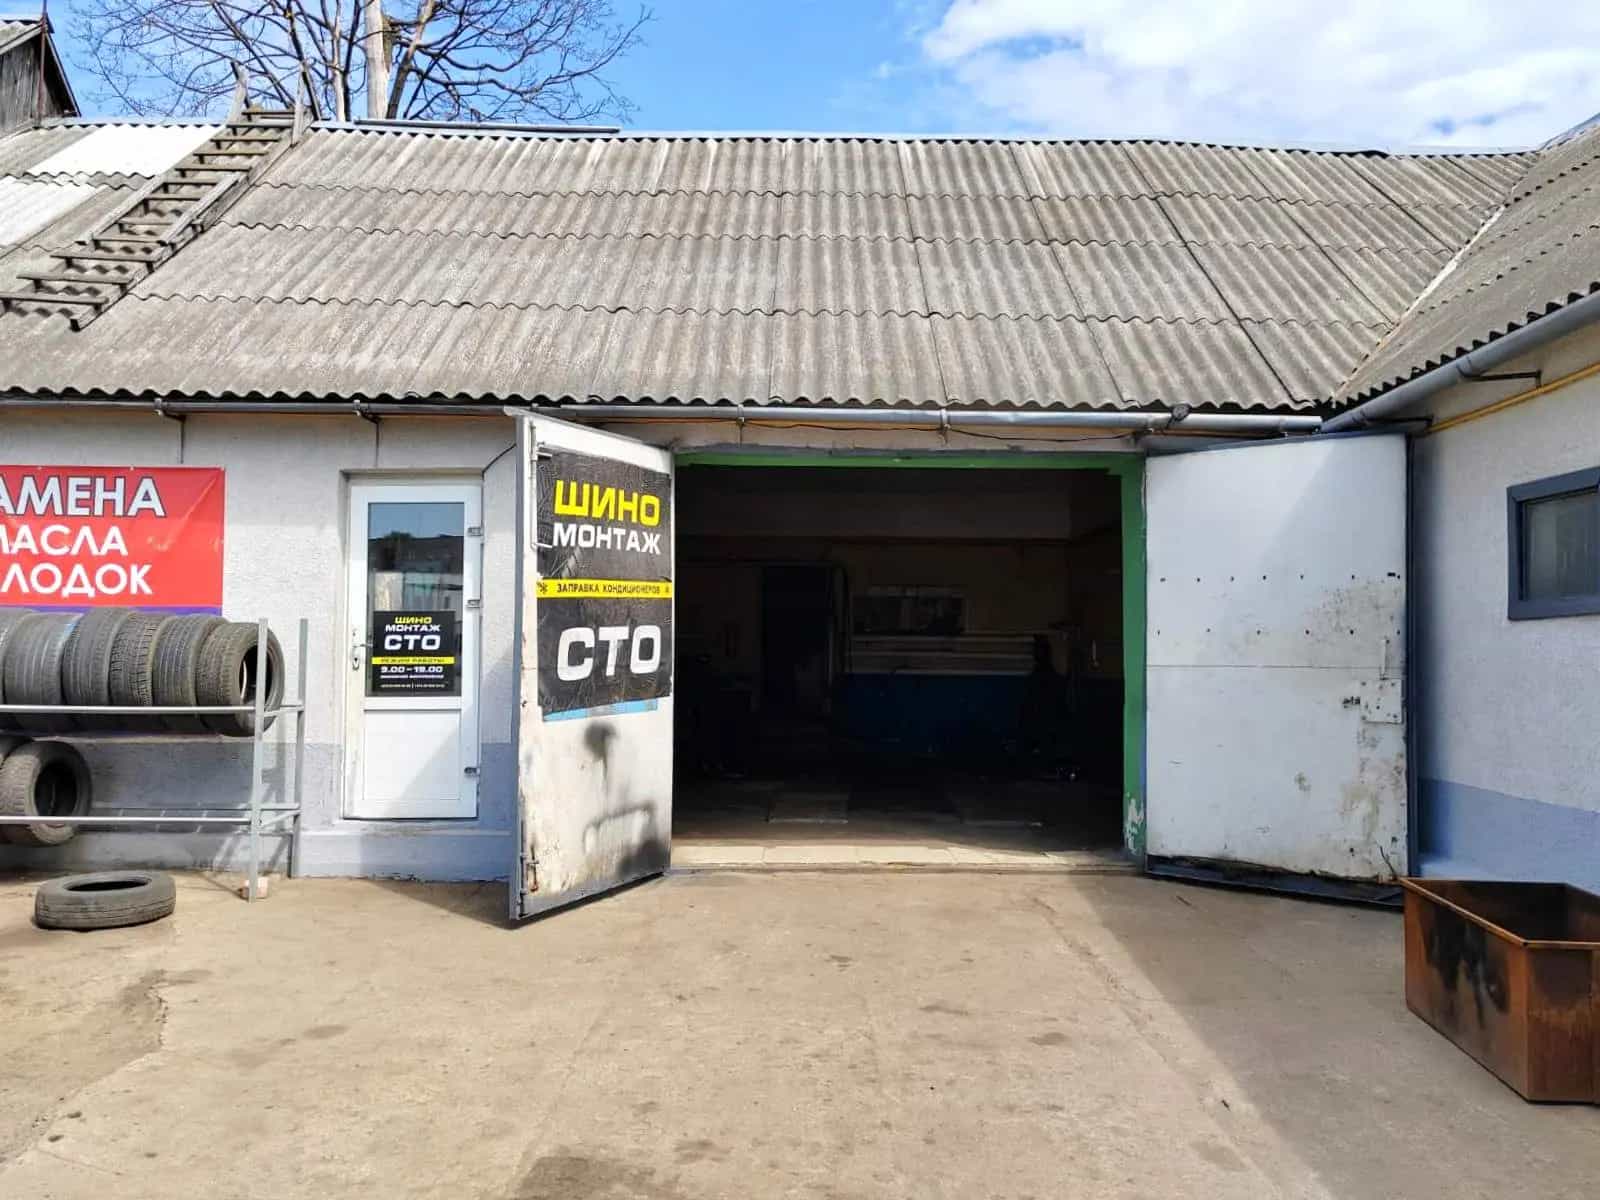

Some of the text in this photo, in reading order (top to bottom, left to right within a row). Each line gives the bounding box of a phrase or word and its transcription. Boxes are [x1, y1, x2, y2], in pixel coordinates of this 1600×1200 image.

[554, 480, 660, 526] ШИНО
[0, 524, 129, 556] АСЛА
[552, 522, 661, 555] МОНТАЖ
[556, 583, 661, 595] ЗАПРАВКА КОНДИЦИОНЕРОВ
[385, 624, 441, 632] МОНТАЖ
[394, 616, 433, 624] ШИНО
[384, 634, 441, 650] СТО
[557, 625, 661, 681] СТО
